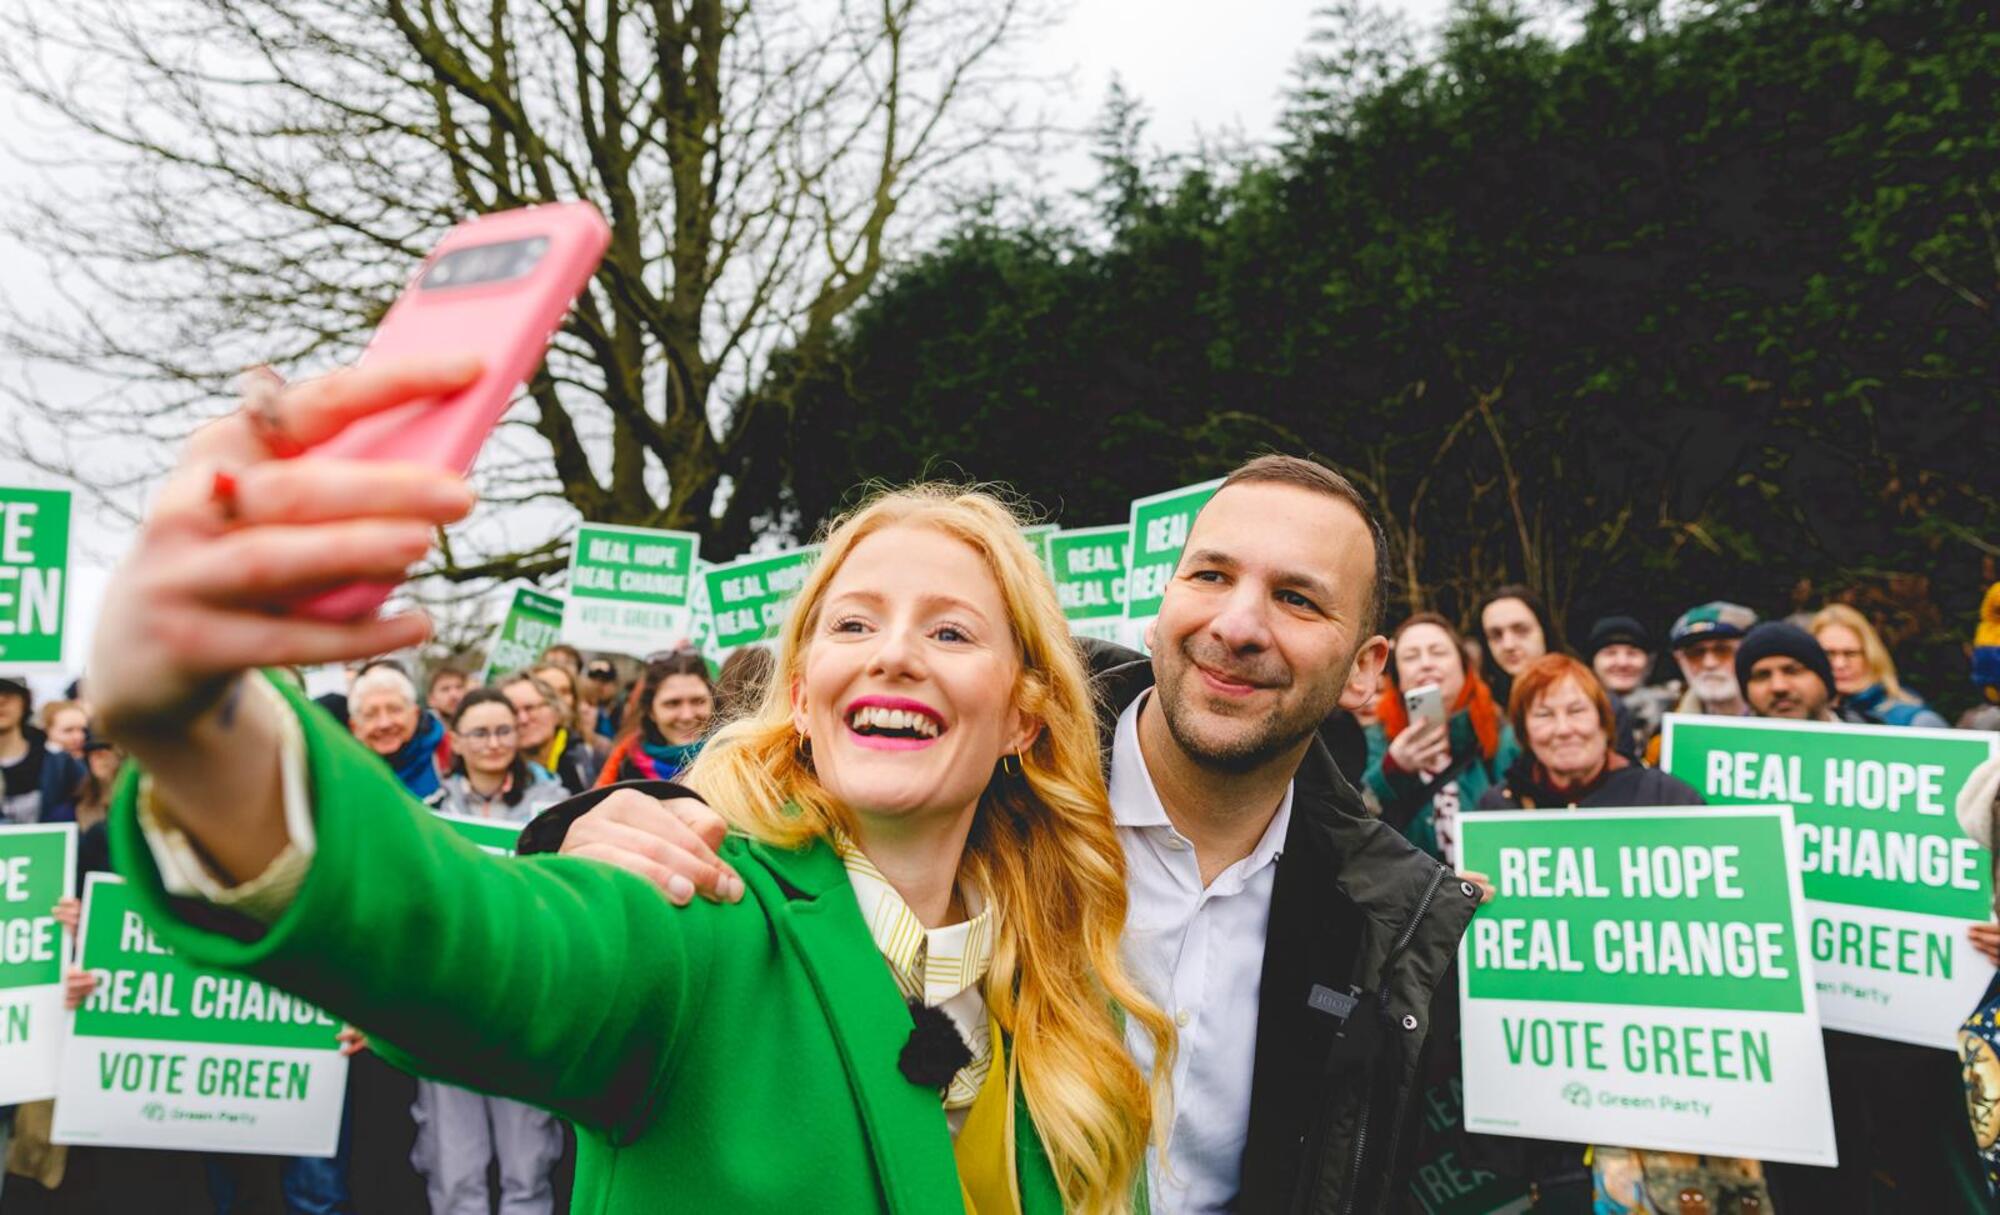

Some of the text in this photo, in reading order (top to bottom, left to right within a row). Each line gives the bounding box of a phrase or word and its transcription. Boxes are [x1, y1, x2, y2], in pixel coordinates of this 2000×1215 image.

[0, 502, 38, 563] E
[588, 537, 677, 569] REAL HOPE
[576, 565, 686, 598] REAL CHANGE
[1066, 545, 1119, 575] REAL
[721, 575, 766, 603] REAL
[1056, 580, 1108, 609] REAL
[716, 608, 760, 635] REAL
[1706, 749, 1946, 816] REAL HOPE
[0, 856, 31, 901] E
[1500, 846, 1744, 899] REAL HOPE
[1797, 822, 1981, 891] CHANGE
[1474, 918, 1789, 980] REAL CHANGE
[1811, 918, 1952, 980] GREEN
[84, 967, 180, 1017] REAL
[1502, 1018, 1773, 1083] VOTE GREEN
[99, 1051, 310, 1101] VOTE GREEN
[1598, 1090, 1713, 1118] Green Party
